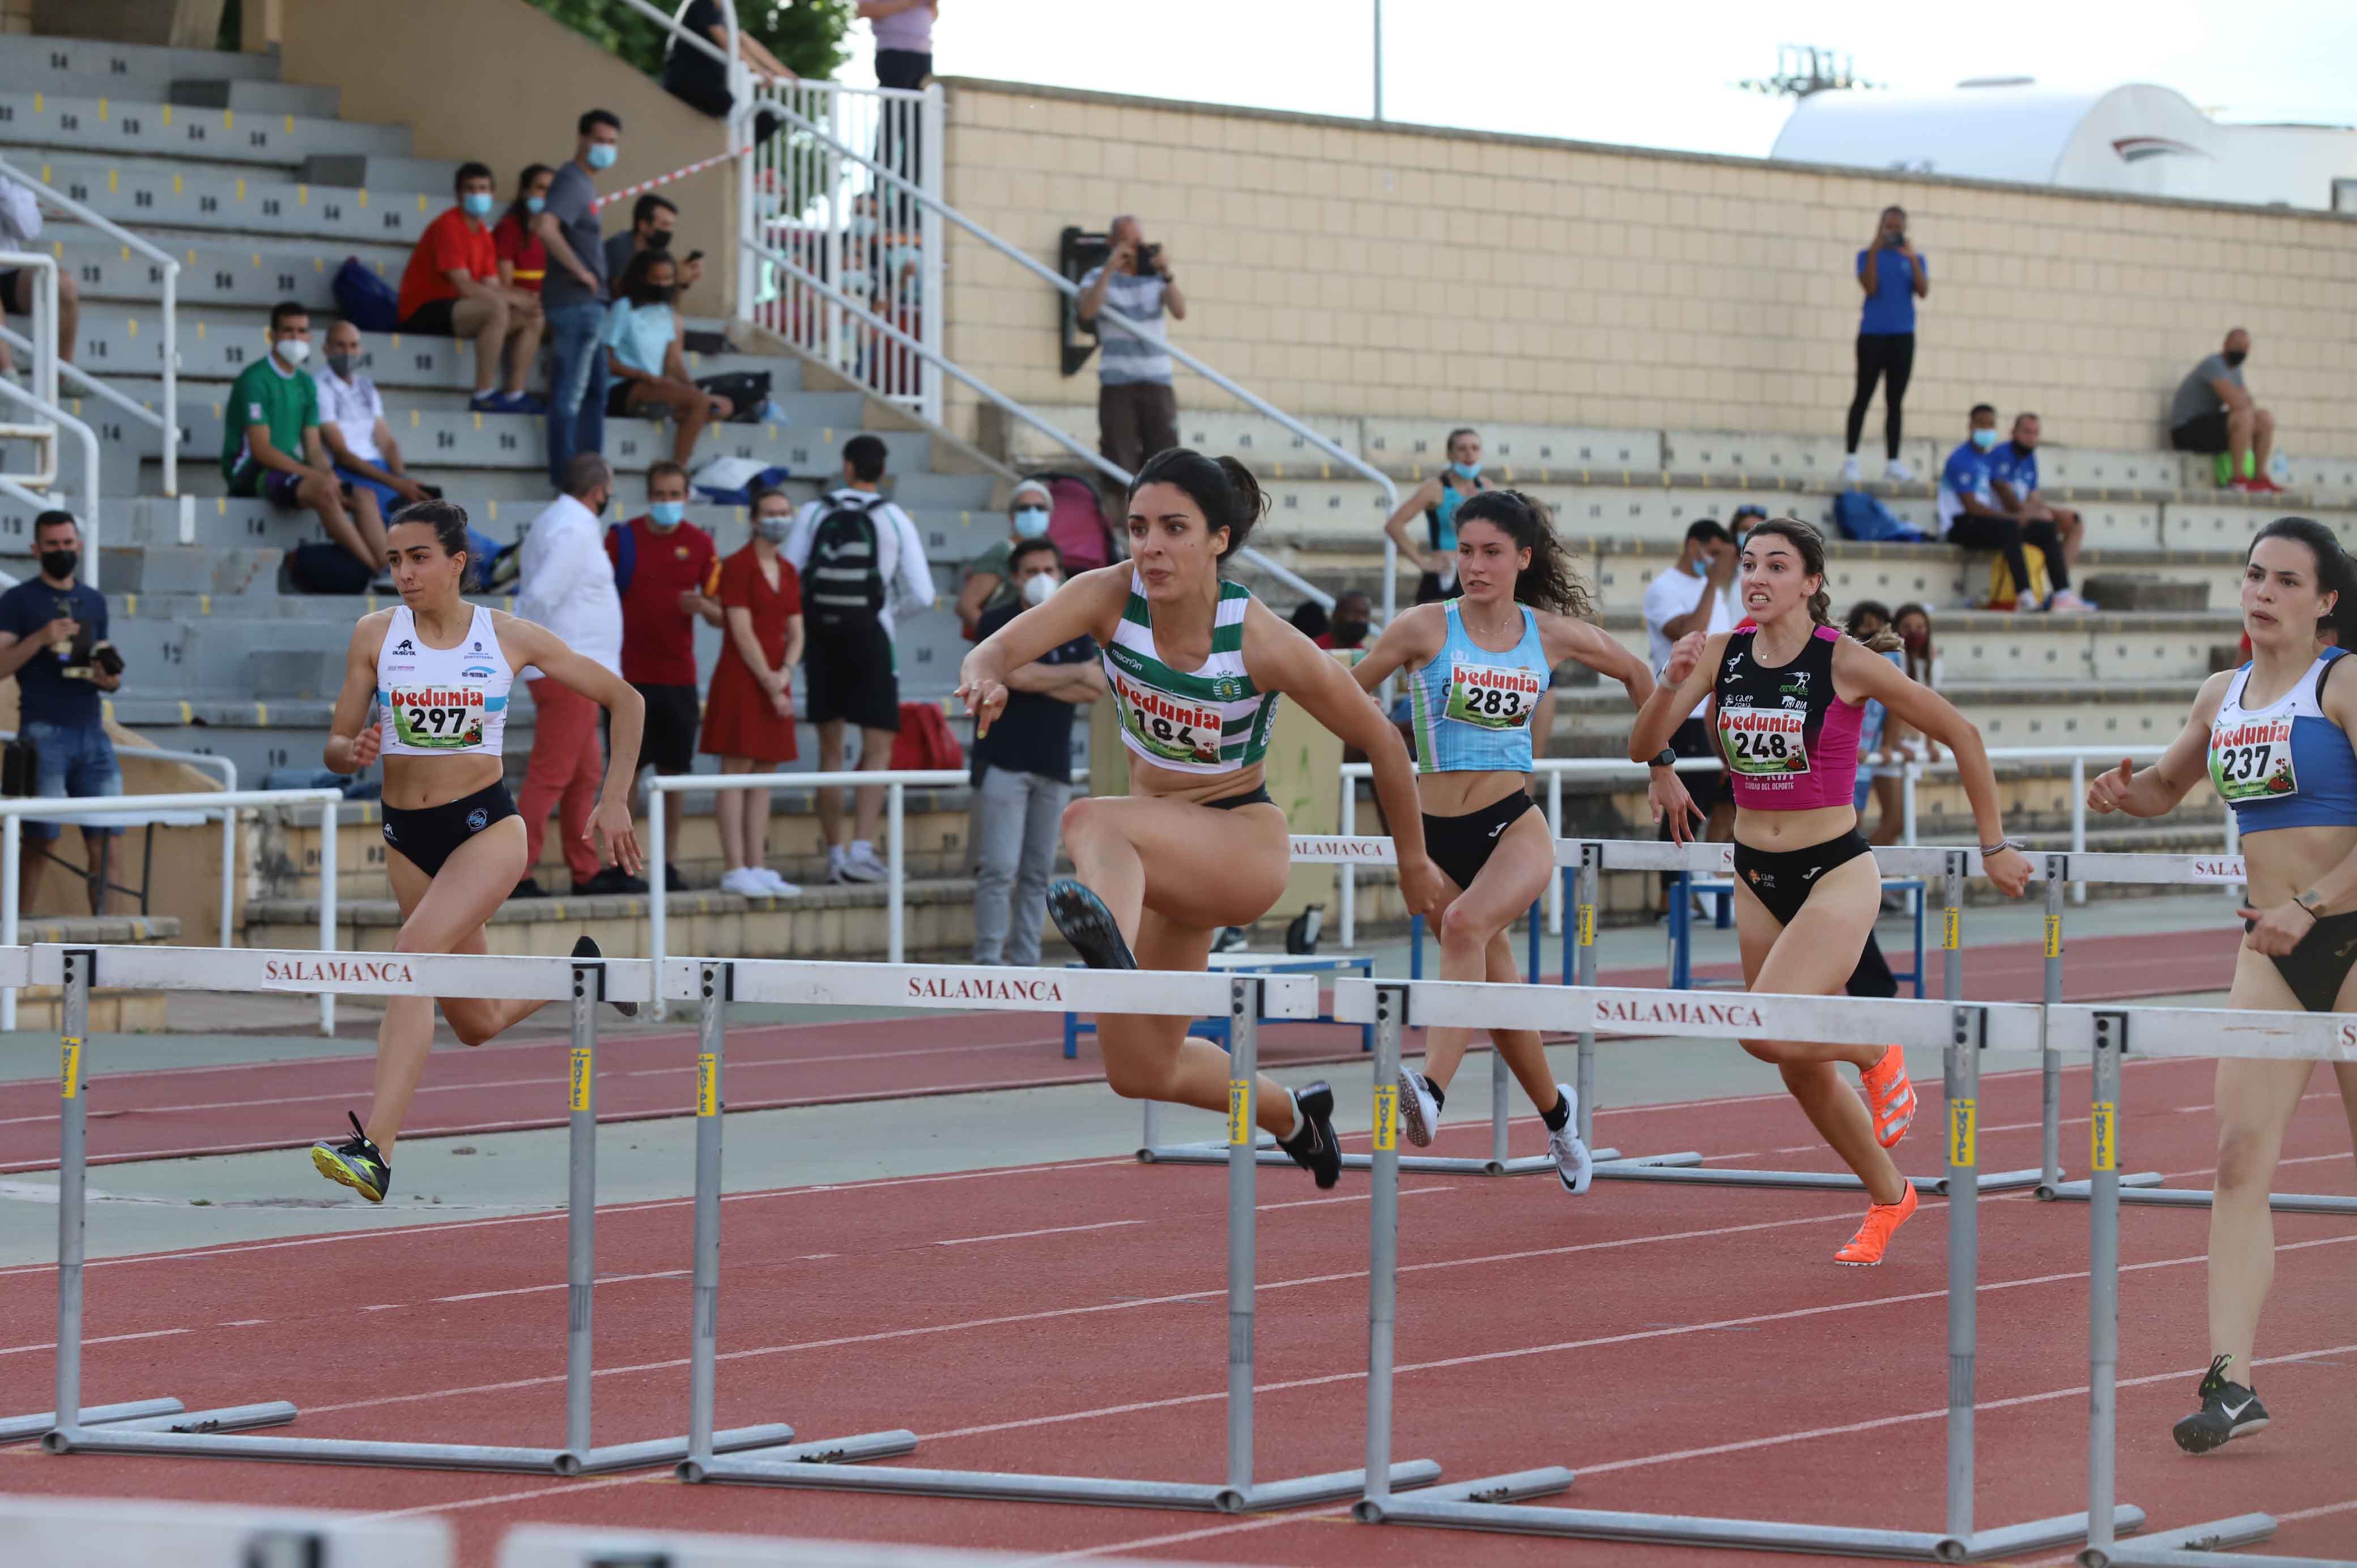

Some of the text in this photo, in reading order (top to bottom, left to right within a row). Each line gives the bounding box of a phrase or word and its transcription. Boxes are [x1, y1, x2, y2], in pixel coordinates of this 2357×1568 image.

[1112, 649, 1143, 671] macron
[1453, 666, 1538, 694] bedunia
[392, 688, 483, 707] bedunia
[1116, 674, 1221, 731] bedunia
[1465, 687, 1520, 715] 283
[409, 708, 466, 734] 297
[1719, 711, 1802, 733] bedunia
[1734, 732, 1787, 759] 248
[2212, 720, 2290, 751] bedunia
[2222, 744, 2271, 782] 237
[1772, 782, 1794, 790] DEPORTE
[1291, 842, 1382, 857] ALAMANCA
[2194, 861, 2246, 875] SALA
[265, 960, 413, 982] SALAMANCA
[908, 977, 1063, 1002] SALAMANCA
[1596, 1000, 1763, 1026] SALAMANCA
[574, 1059, 583, 1107] MOYPE
[699, 1064, 708, 1113] MOYPE
[1232, 1092, 1241, 1141] MOYPE
[1379, 1096, 1390, 1147] MOYPE
[1957, 1110, 1968, 1162] MOYPE
[2095, 1114, 2106, 1167] MOYPE
